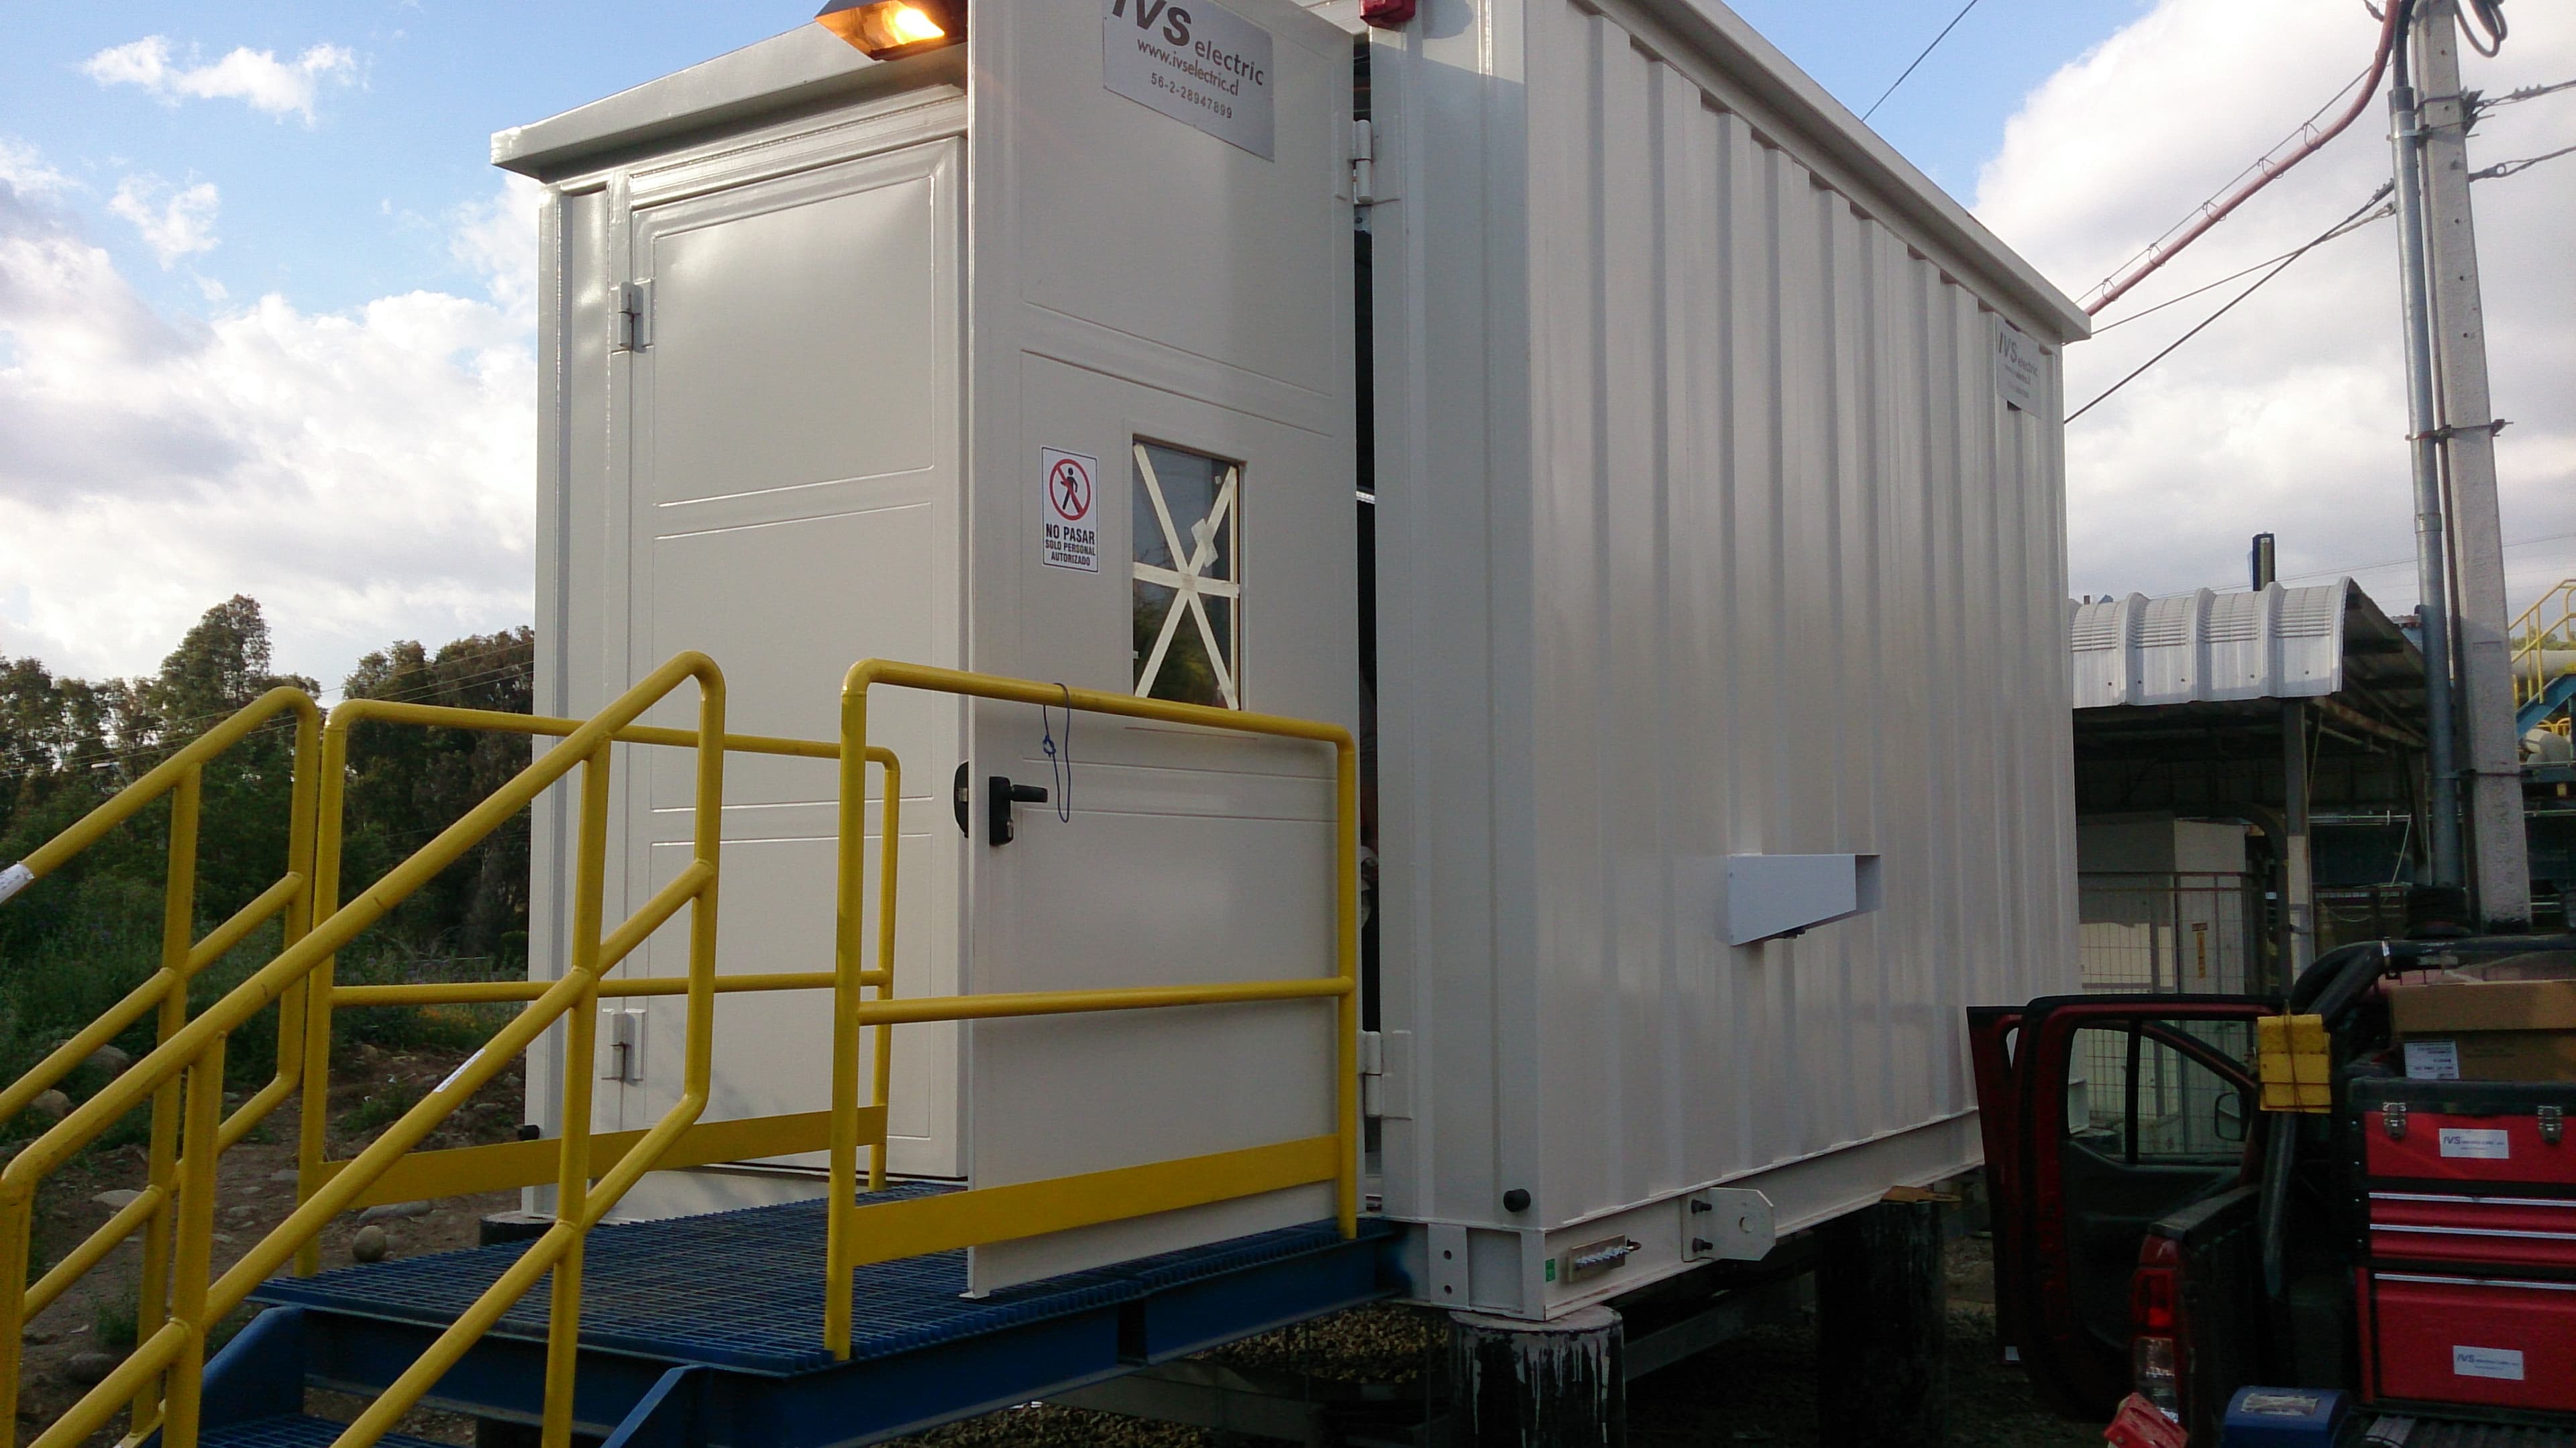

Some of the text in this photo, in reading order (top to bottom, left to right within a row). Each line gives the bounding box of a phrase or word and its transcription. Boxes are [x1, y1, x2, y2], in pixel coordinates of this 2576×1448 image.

[1137, 39, 1239, 96] www.ivselectric.cl
[1195, 40, 1264, 86] electric
[1998, 332, 2018, 363] IVS
[1046, 523, 1095, 545] NO PASAR
[1045, 539, 1095, 556] SOLO PERSONAL
[1051, 551, 1090, 566] AUTORIZADO
